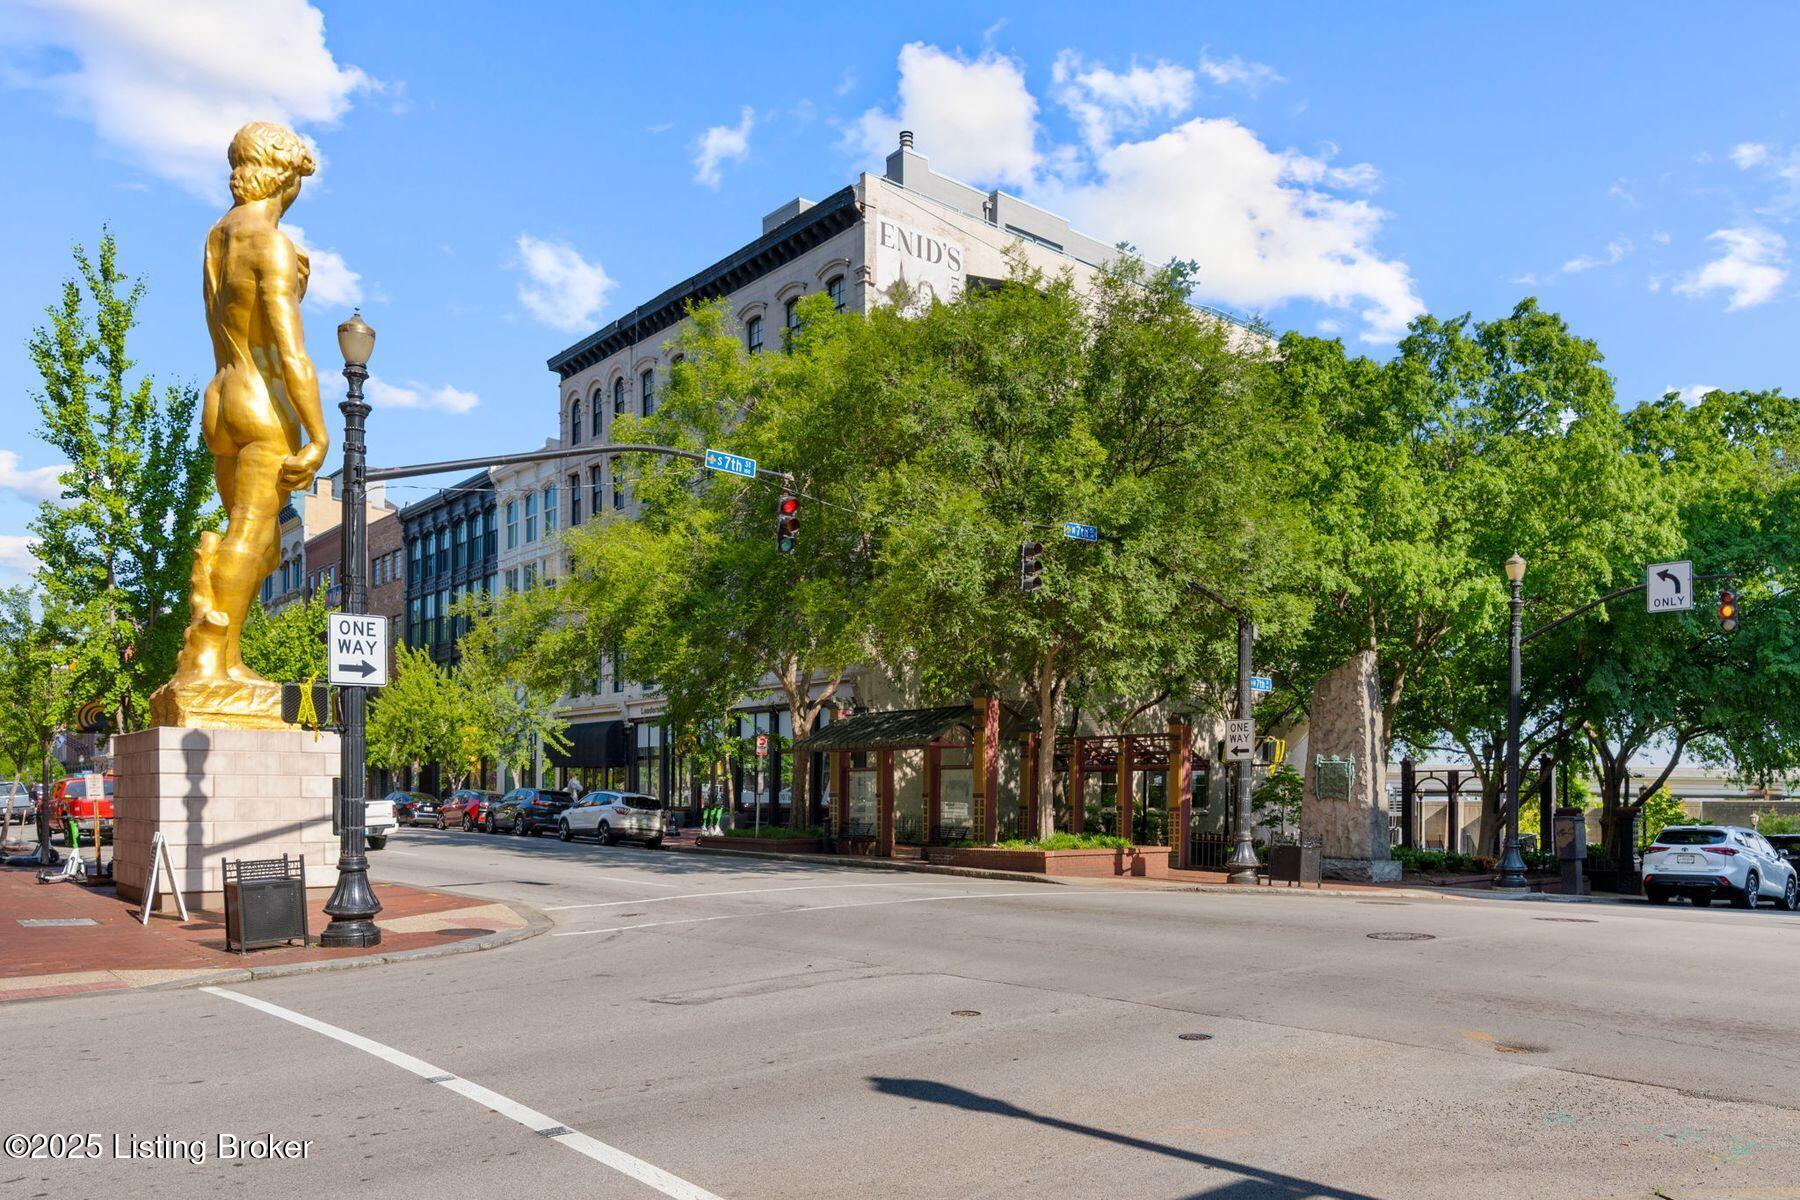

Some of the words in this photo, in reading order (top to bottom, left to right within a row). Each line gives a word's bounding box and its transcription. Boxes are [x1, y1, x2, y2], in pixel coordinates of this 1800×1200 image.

[880, 221, 960, 272] ENID'S
[717, 456, 723, 466] S
[724, 456, 743, 472] 7th
[1653, 596, 1684, 607] ONLY
[339, 620, 376, 637] ONE
[338, 638, 377, 655] WAY
[1230, 722, 1249, 733] ONE
[1230, 734, 1249, 743] WAY
